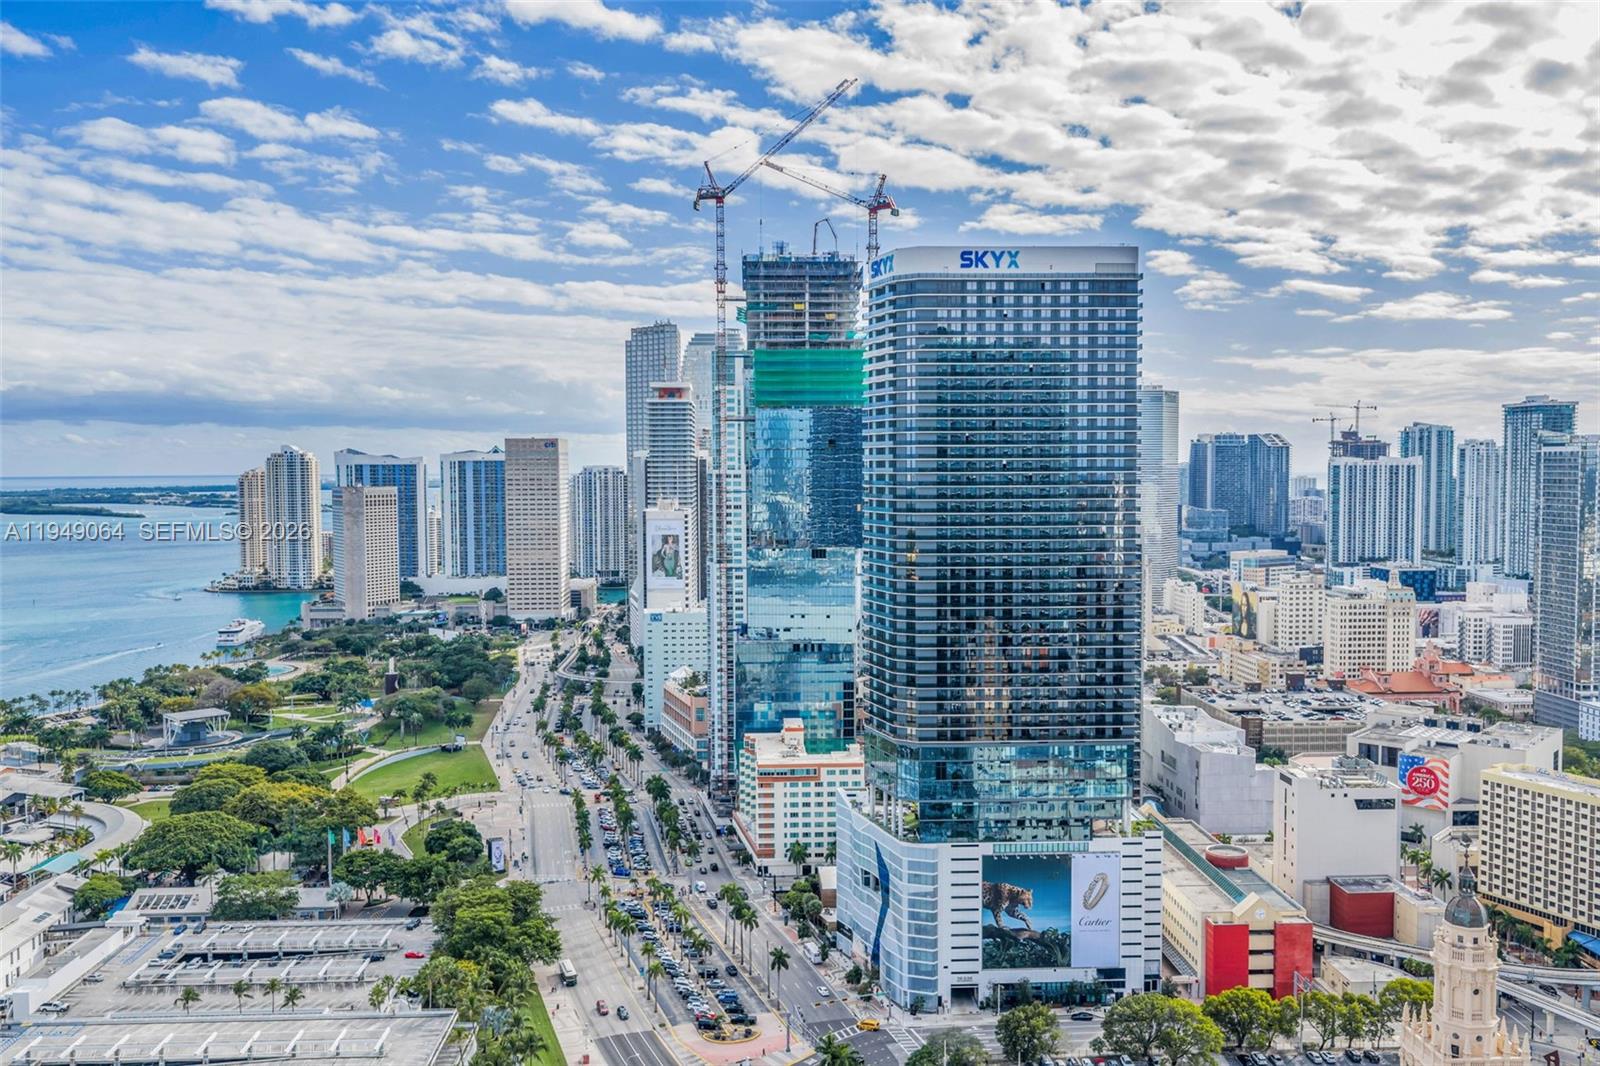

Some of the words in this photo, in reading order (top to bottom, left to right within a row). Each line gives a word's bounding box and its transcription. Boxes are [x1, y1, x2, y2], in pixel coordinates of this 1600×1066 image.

[871, 254, 894, 279] SKYX
[960, 250, 1020, 269] SKYX
[1412, 775, 1435, 789] 250
[1078, 916, 1112, 926] Cartier
